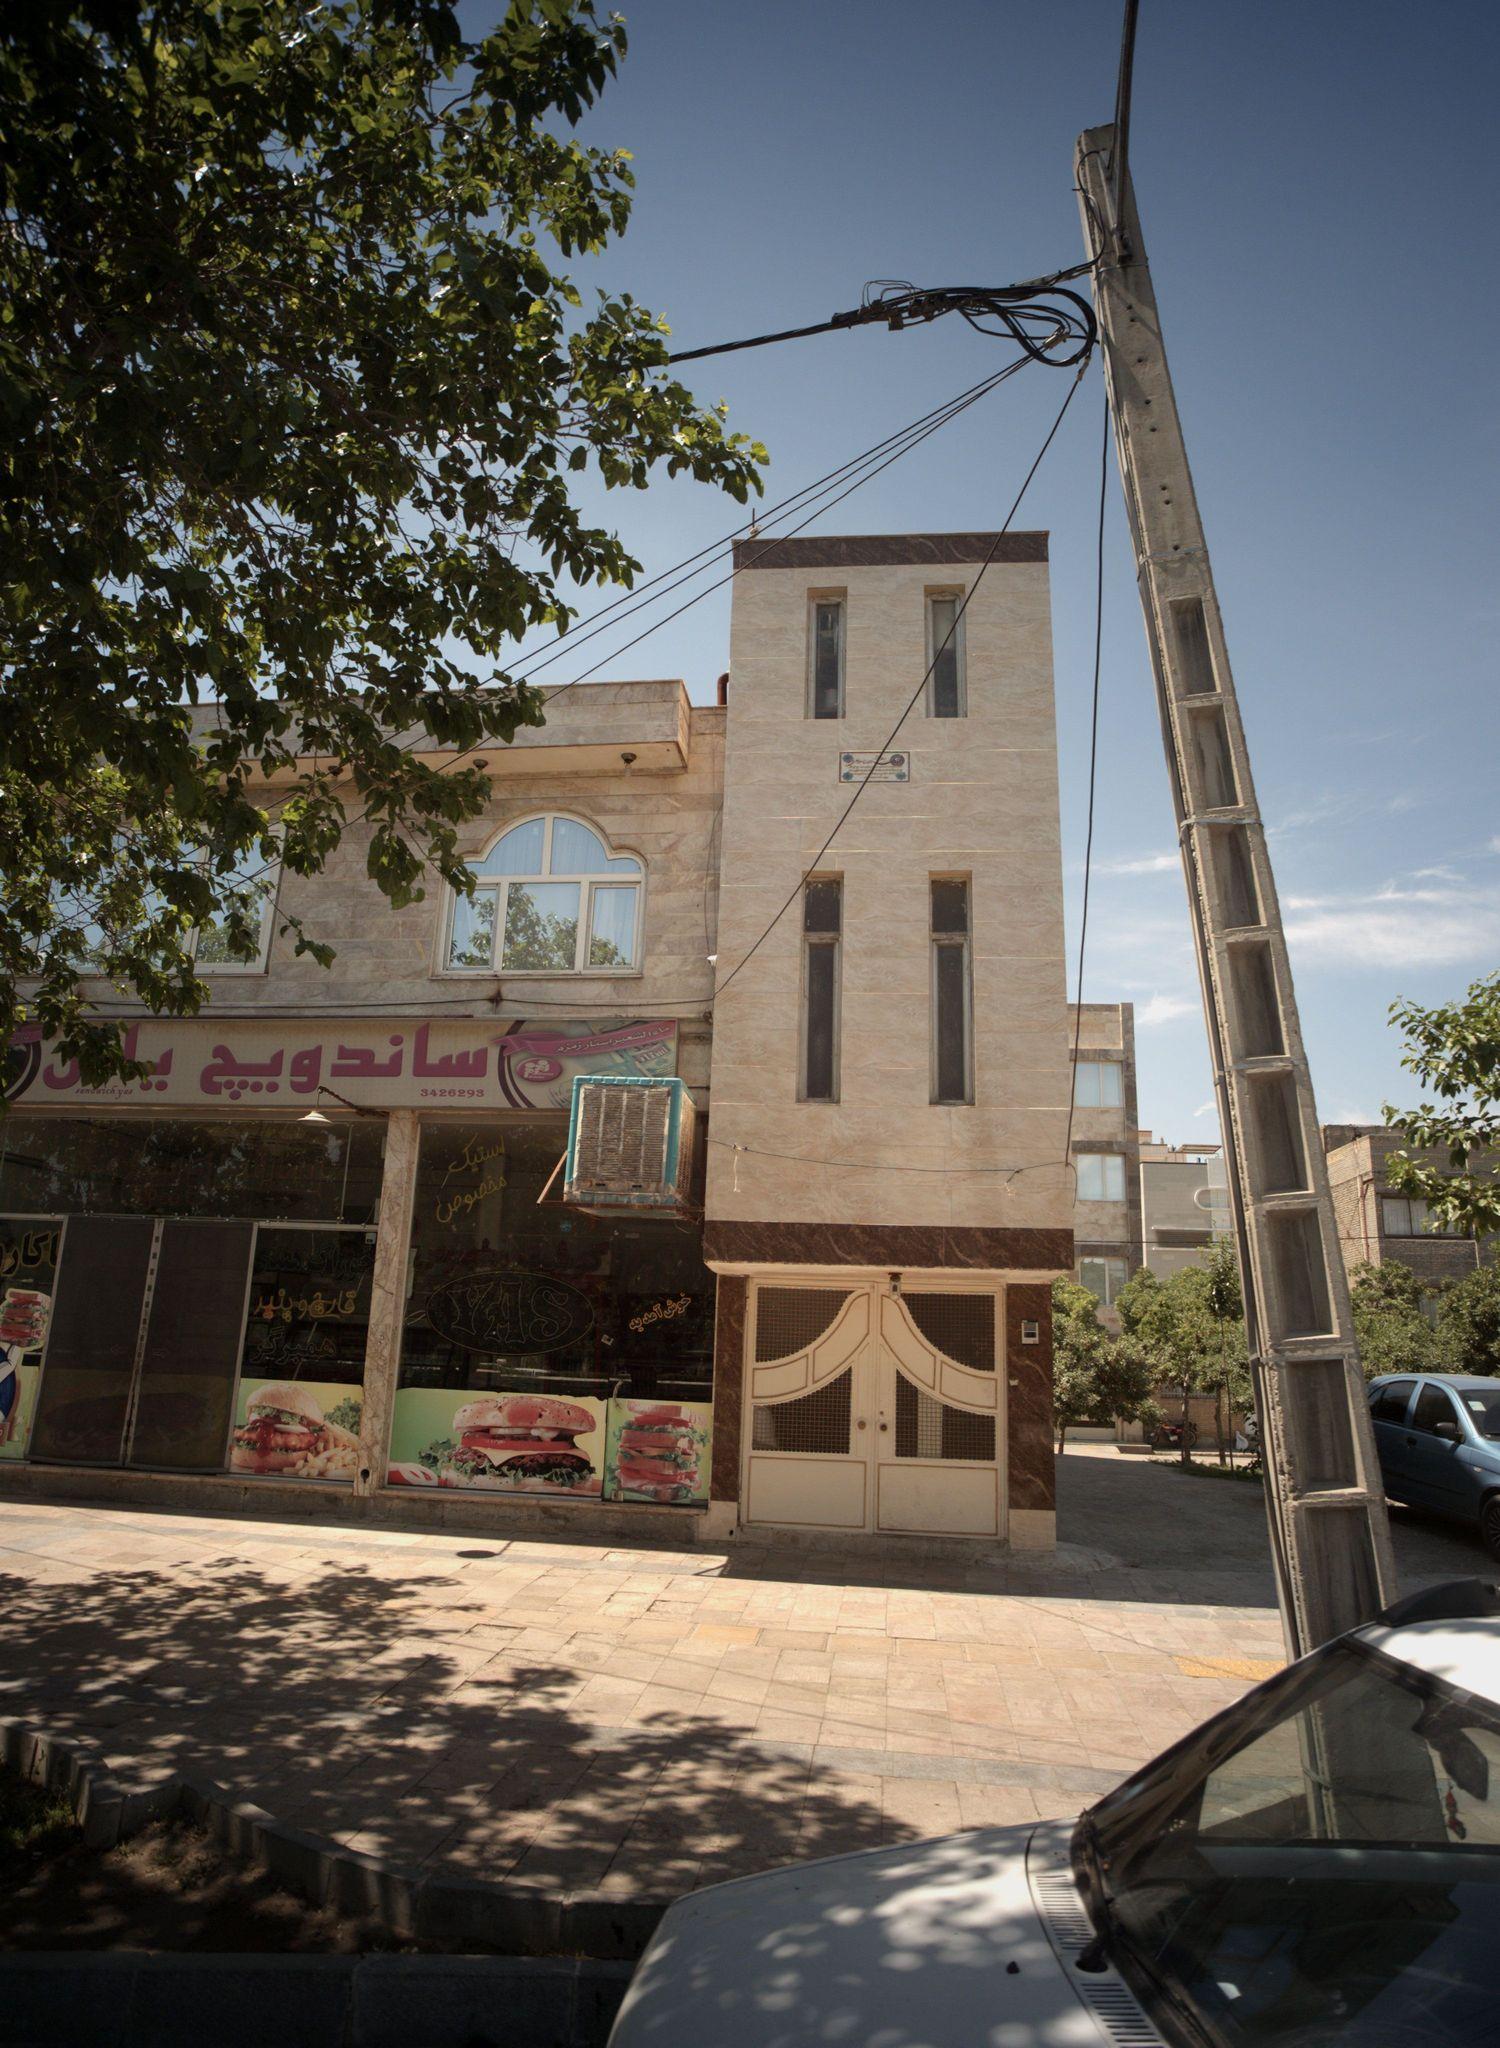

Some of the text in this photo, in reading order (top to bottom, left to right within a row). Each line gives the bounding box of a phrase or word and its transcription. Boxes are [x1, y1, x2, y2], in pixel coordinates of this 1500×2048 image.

[201, 1022, 487, 1100] ساندویچ
[420, 1088, 485, 1098] 3426293
[308, 1290, 357, 1319] قارچ
[629, 1291, 692, 1332] خوش آمدید
